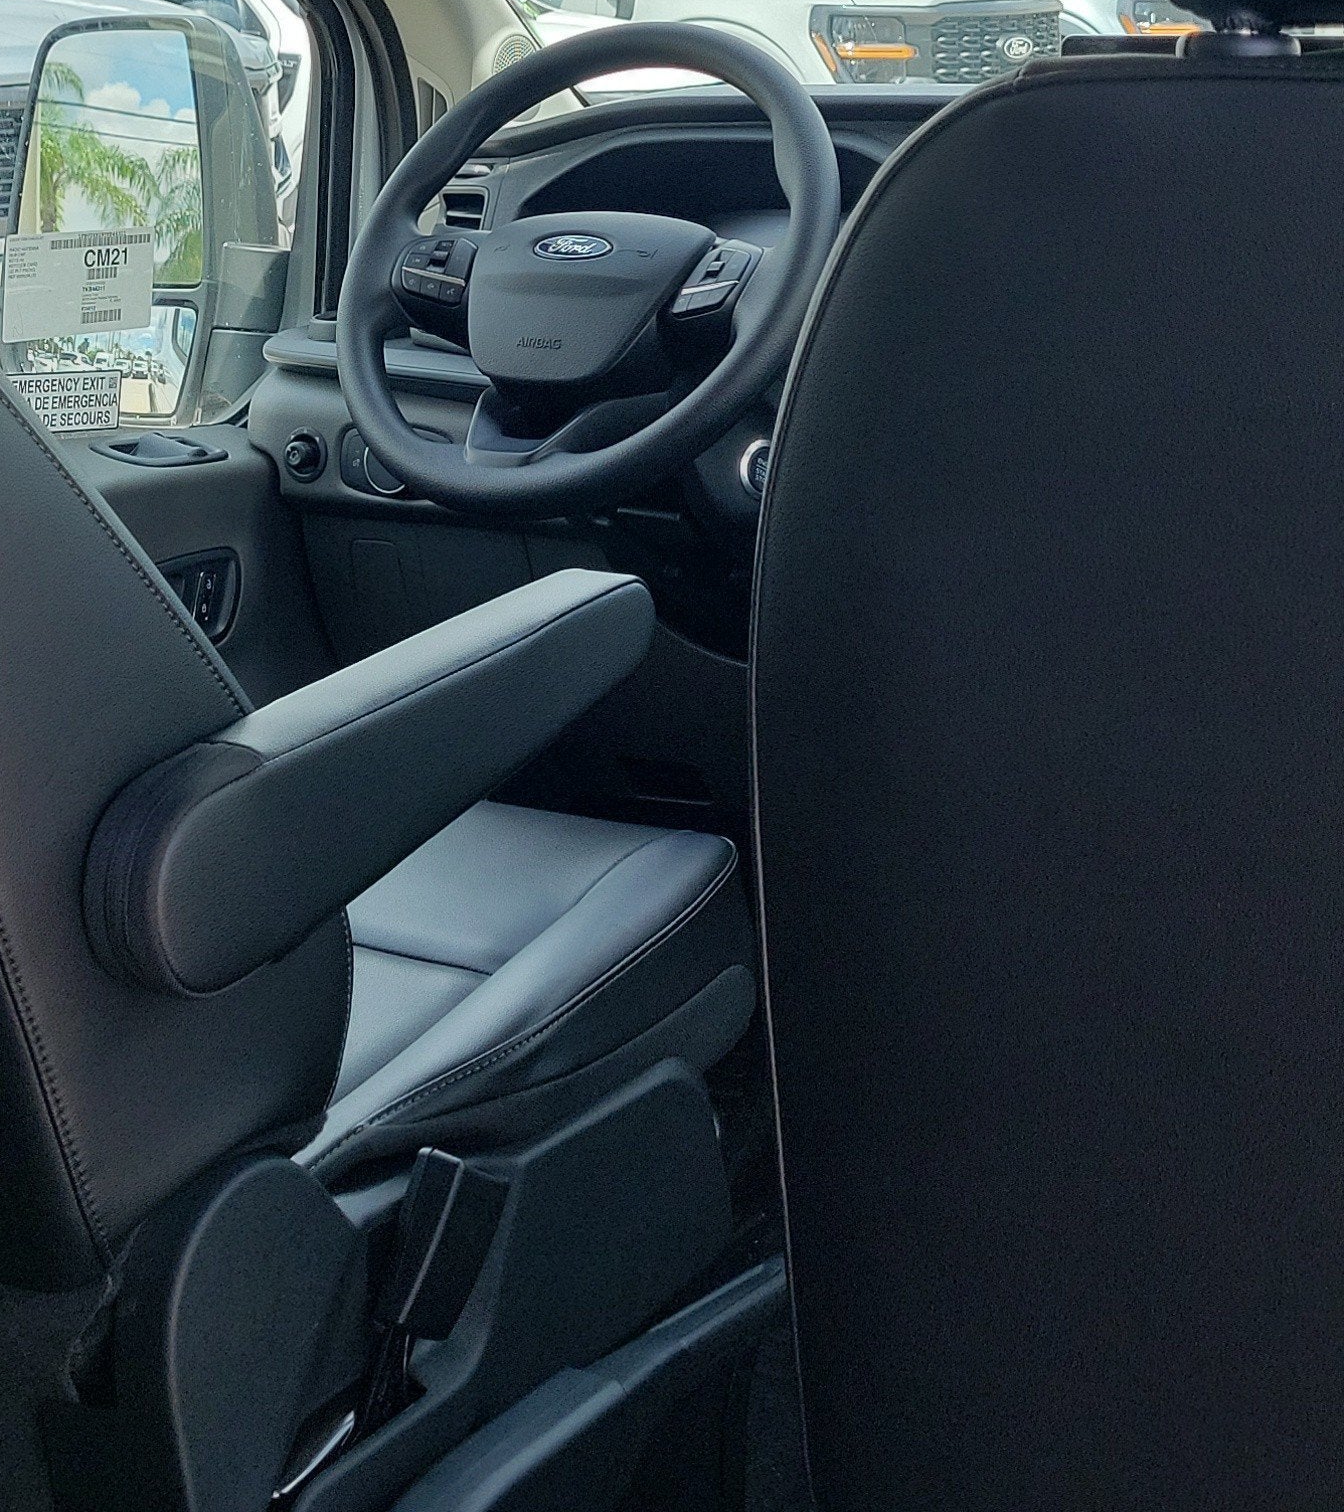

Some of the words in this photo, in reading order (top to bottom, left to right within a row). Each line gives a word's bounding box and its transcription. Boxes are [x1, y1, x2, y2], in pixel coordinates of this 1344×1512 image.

[83, 246, 129, 268] CM21
[516, 337, 561, 350] AIRBAG
[82, 376, 106, 391] EXIT
[35, 396, 49, 410] DE
[51, 392, 117, 409] EMERGENCIA
[59, 410, 110, 427] SECOURS
